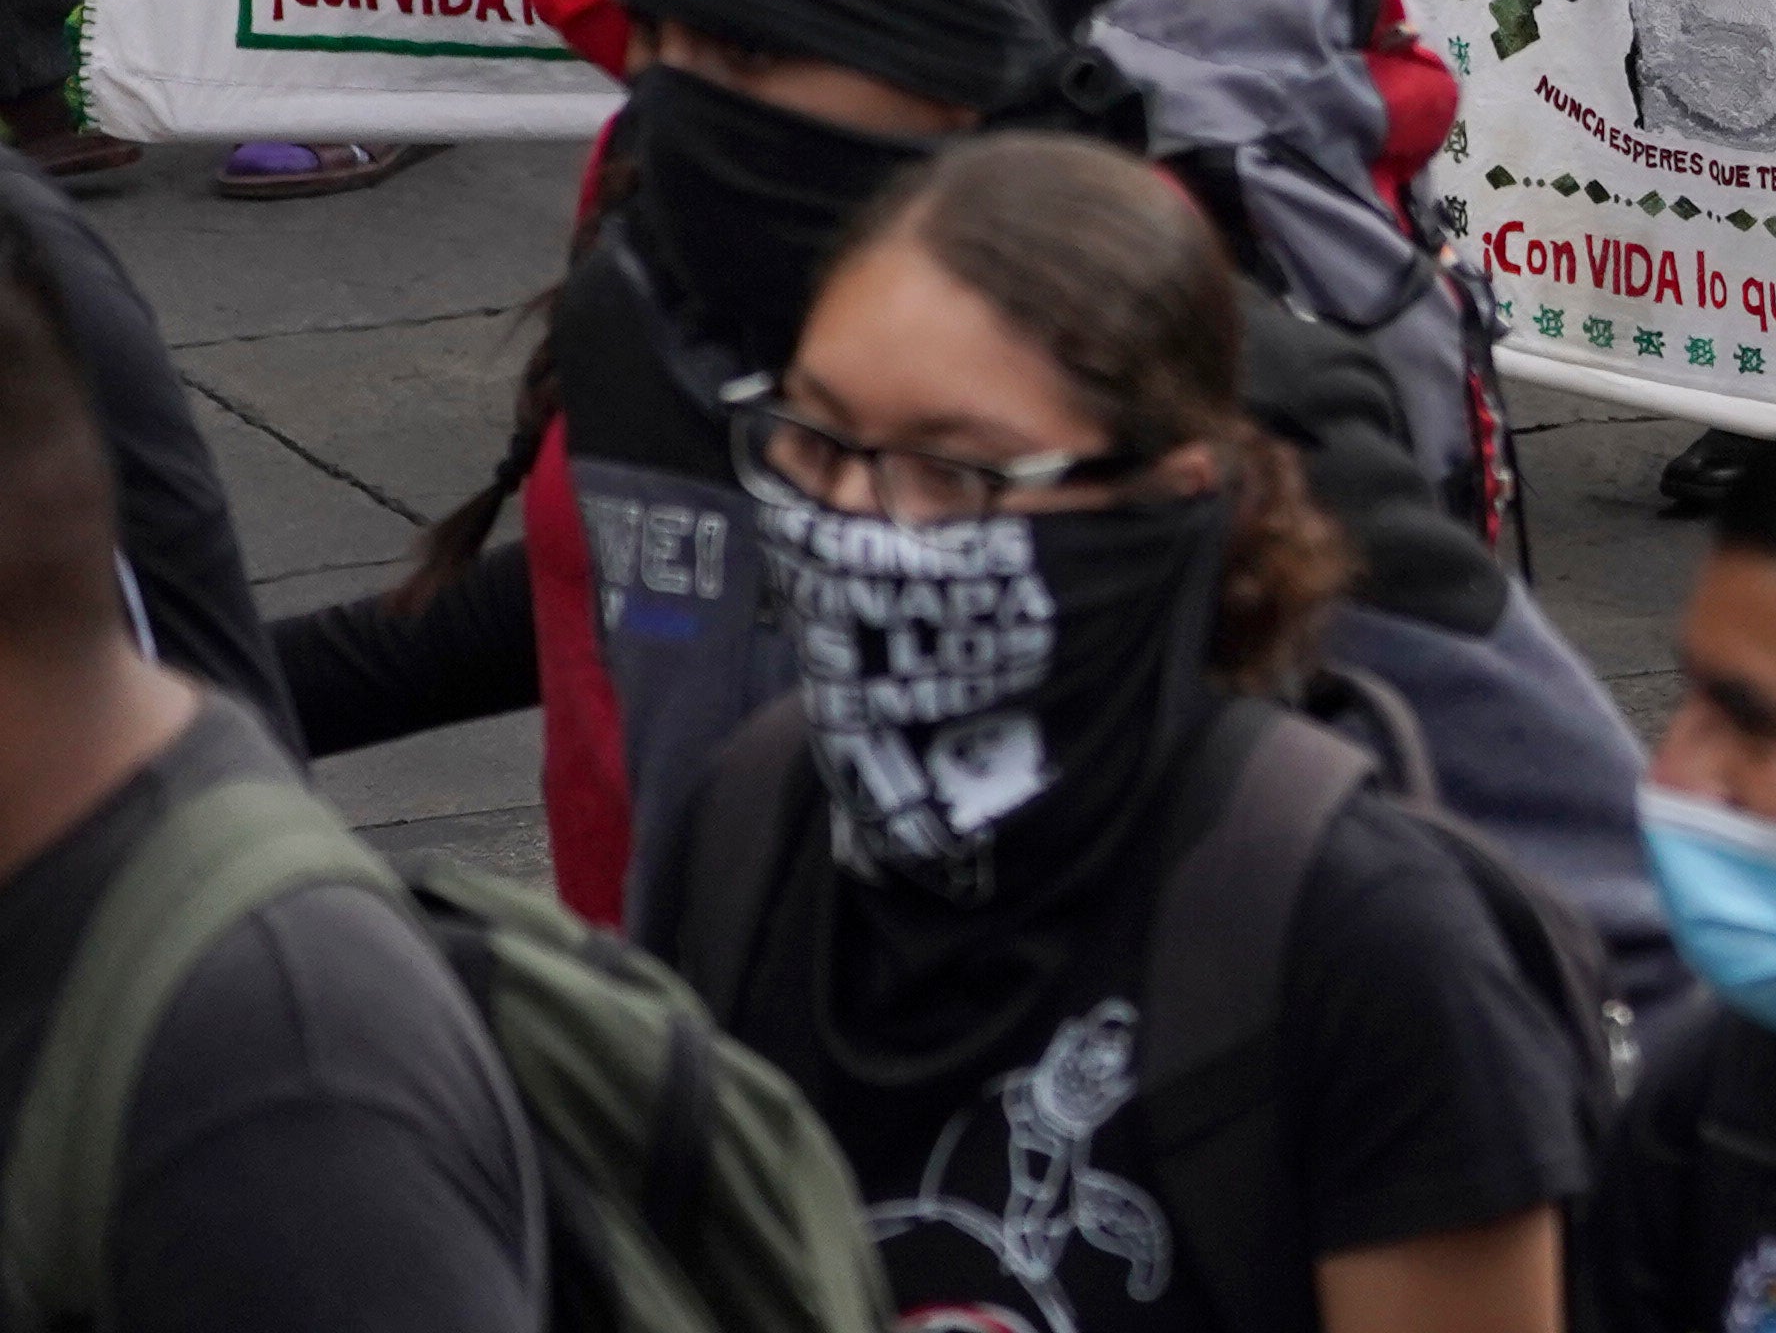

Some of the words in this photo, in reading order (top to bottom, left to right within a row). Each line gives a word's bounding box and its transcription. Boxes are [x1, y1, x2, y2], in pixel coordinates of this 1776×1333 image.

[1533, 73, 1606, 141] NUNCA
[1608, 126, 1704, 176] ESPERES
[1707, 158, 1751, 189] QUE
[1481, 219, 1577, 285] ¡Con
[1584, 232, 1684, 307] VIDA
[1696, 249, 1729, 310] lo
